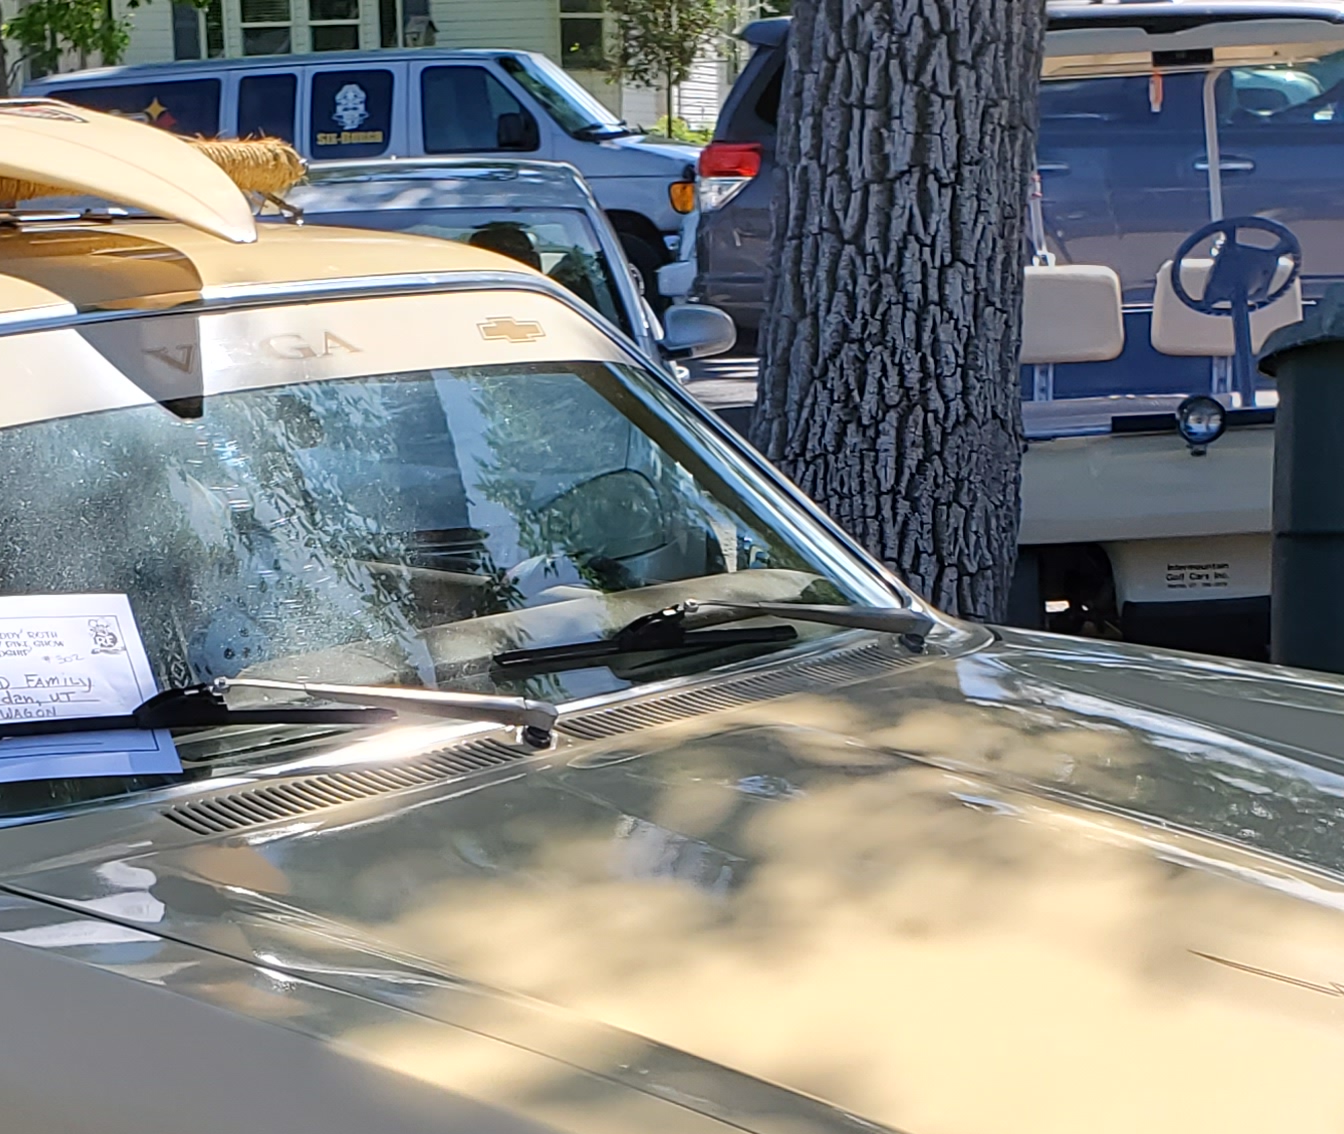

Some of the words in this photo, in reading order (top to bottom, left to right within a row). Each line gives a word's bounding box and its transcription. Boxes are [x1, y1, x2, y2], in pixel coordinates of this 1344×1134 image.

[27, 631, 58, 639] ROTH
[49, 691, 76, 703] UT
[0, 706, 57, 720] WAGON
